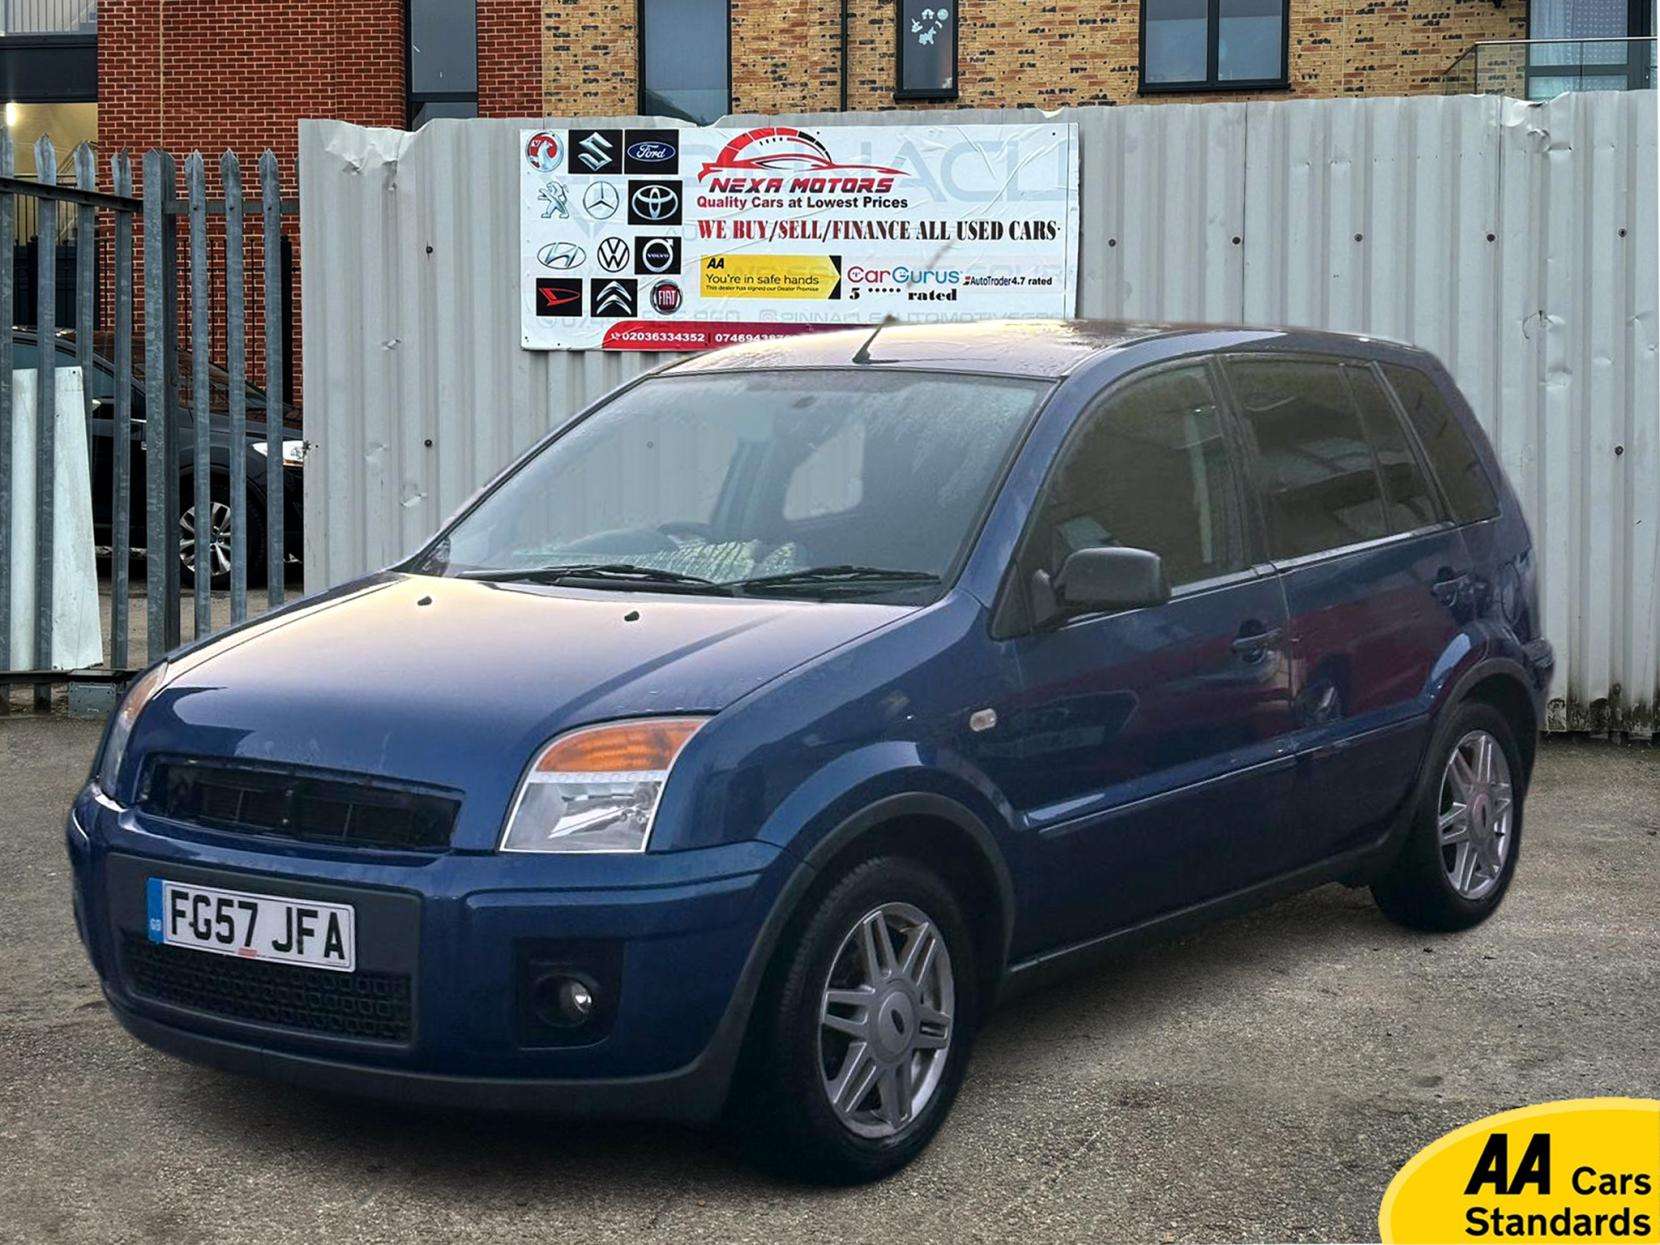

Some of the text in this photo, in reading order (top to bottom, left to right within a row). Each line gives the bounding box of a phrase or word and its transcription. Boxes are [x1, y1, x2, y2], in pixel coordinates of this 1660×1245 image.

[636, 145, 666, 159] Ford
[708, 177, 895, 194] NEXA MOTORS
[697, 196, 908, 211] Quality Cars at Lowest Prices
[697, 220, 727, 240] WE
[916, 221, 951, 240] ALL
[956, 220, 1004, 241] USED
[1008, 220, 1057, 241] CARS
[706, 257, 725, 270] AA
[706, 274, 819, 285] You're in safe hands
[847, 266, 960, 284] CarGurus
[1027, 276, 1053, 286] rated
[658, 290, 677, 305] FIAT
[849, 287, 958, 301] 5 rated
[715, 333, 799, 342] 0746943
[170, 889, 345, 960] FG57 JFA
